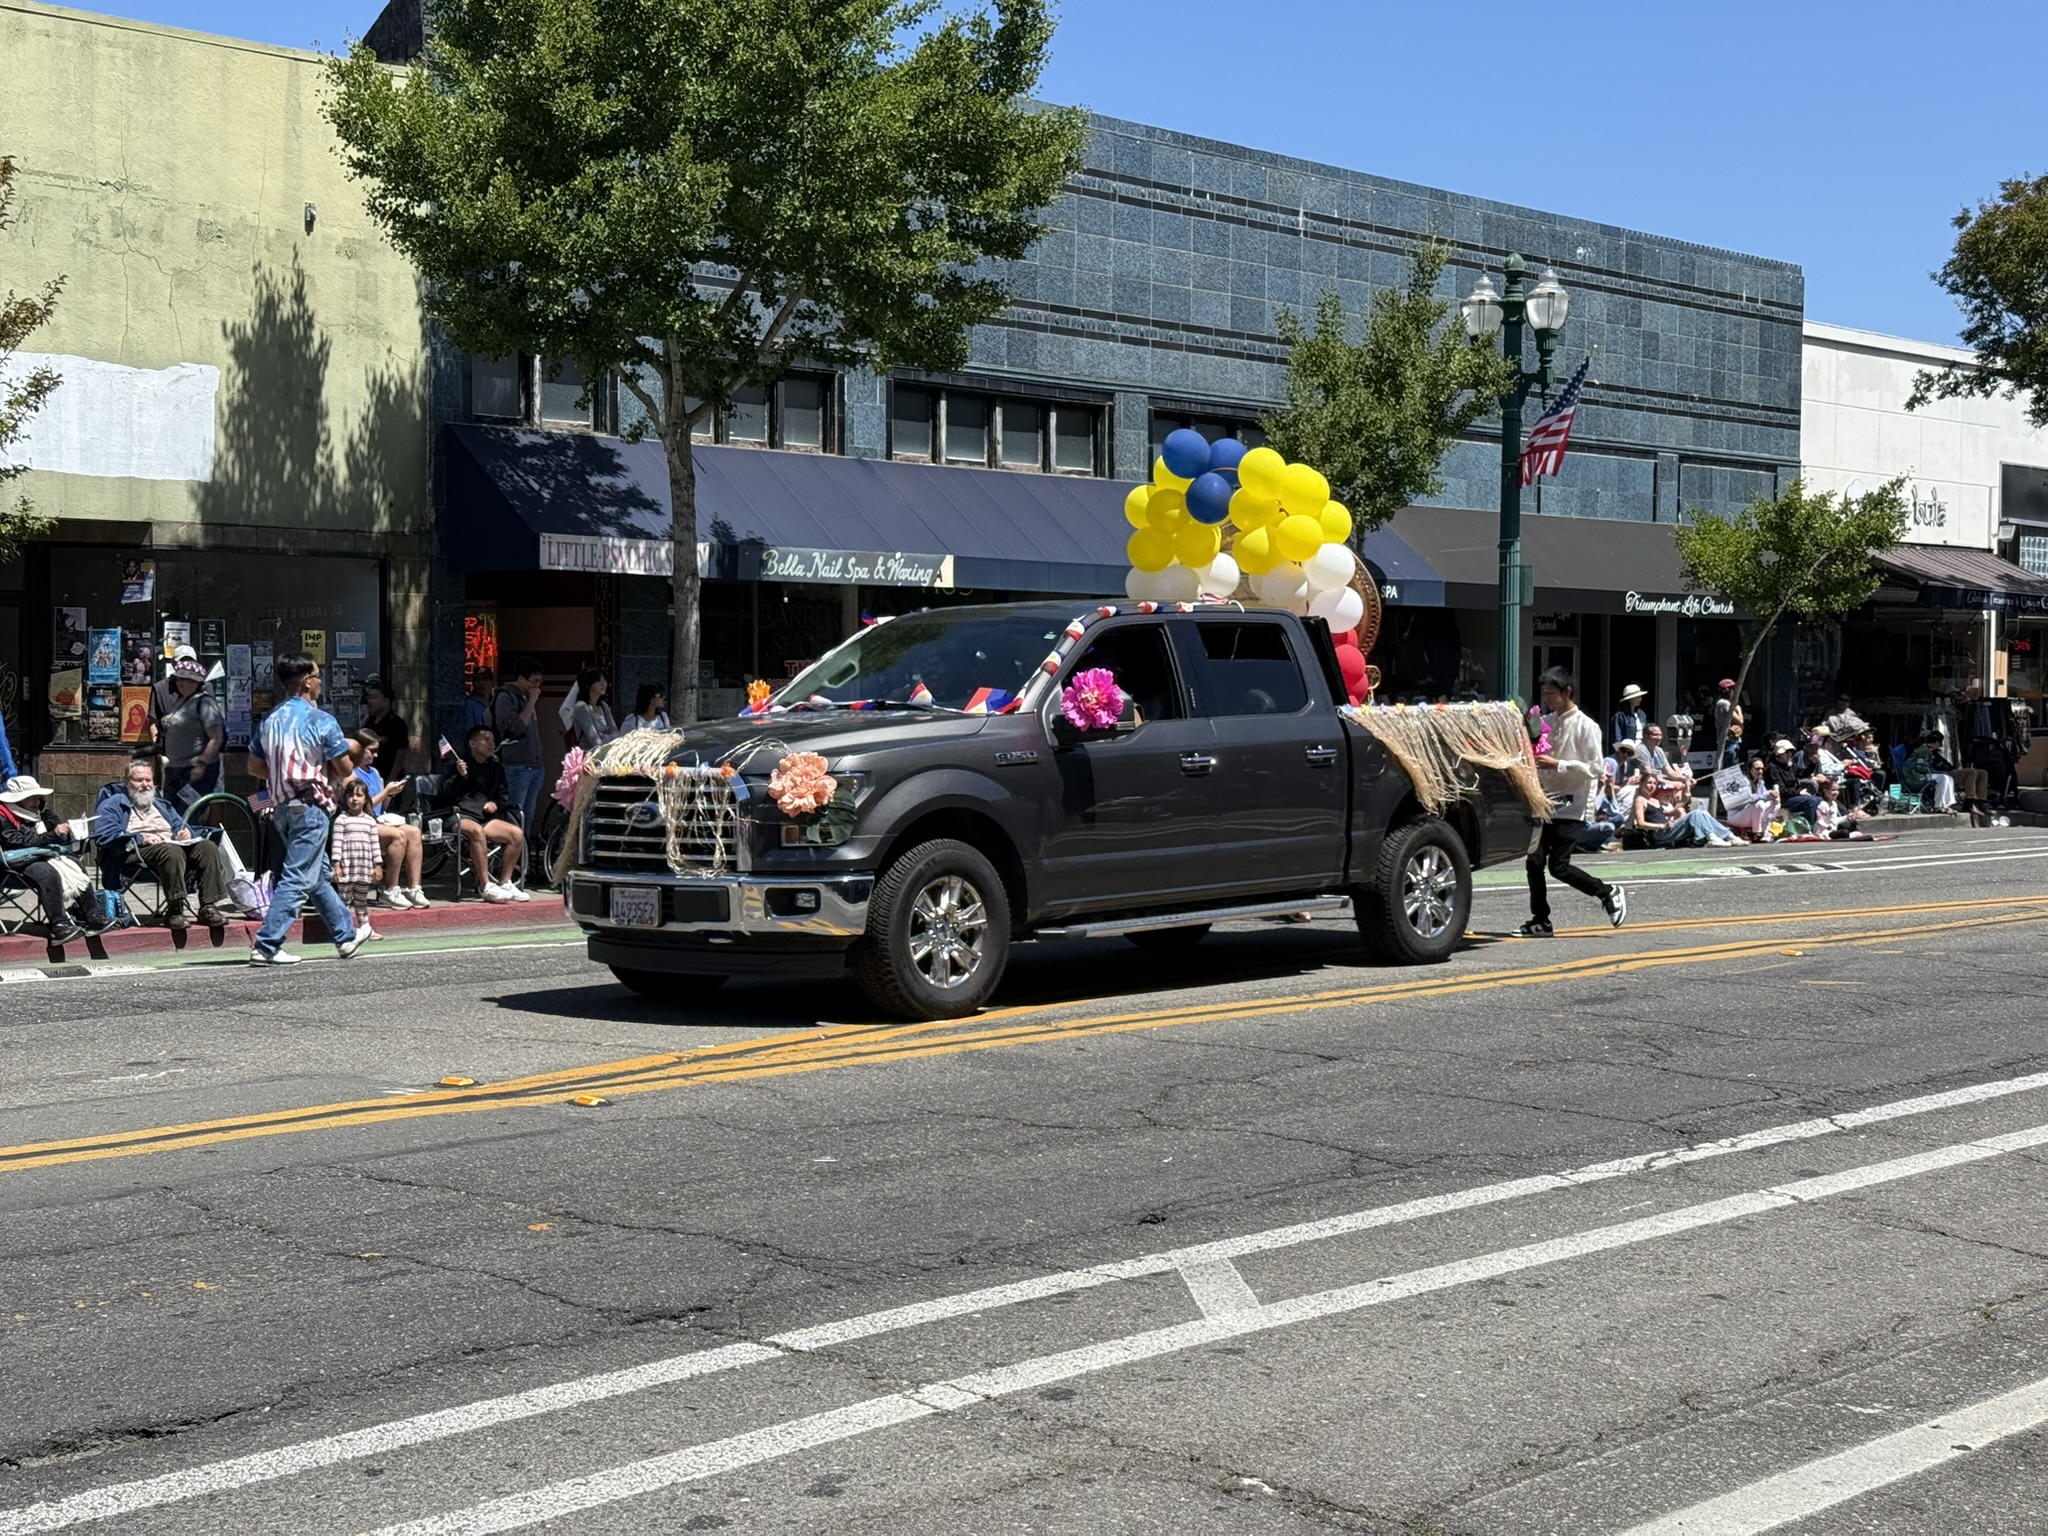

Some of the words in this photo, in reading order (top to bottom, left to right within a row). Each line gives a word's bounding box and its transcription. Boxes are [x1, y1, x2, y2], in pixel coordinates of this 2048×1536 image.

[547, 540, 600, 570] LITTLE
[762, 550, 806, 576] Bella
[807, 552, 843, 579] Nail
[845, 556, 871, 583] Spa
[873, 556, 887, 580] &
[887, 557, 934, 586] Waxing
[1380, 584, 1399, 599] SPA
[1625, 590, 1682, 616] Triumphant
[1682, 594, 1701, 618] Life
[1701, 596, 1735, 615] Church
[304, 633, 322, 641] IMP
[304, 641, 320, 649] ROV
